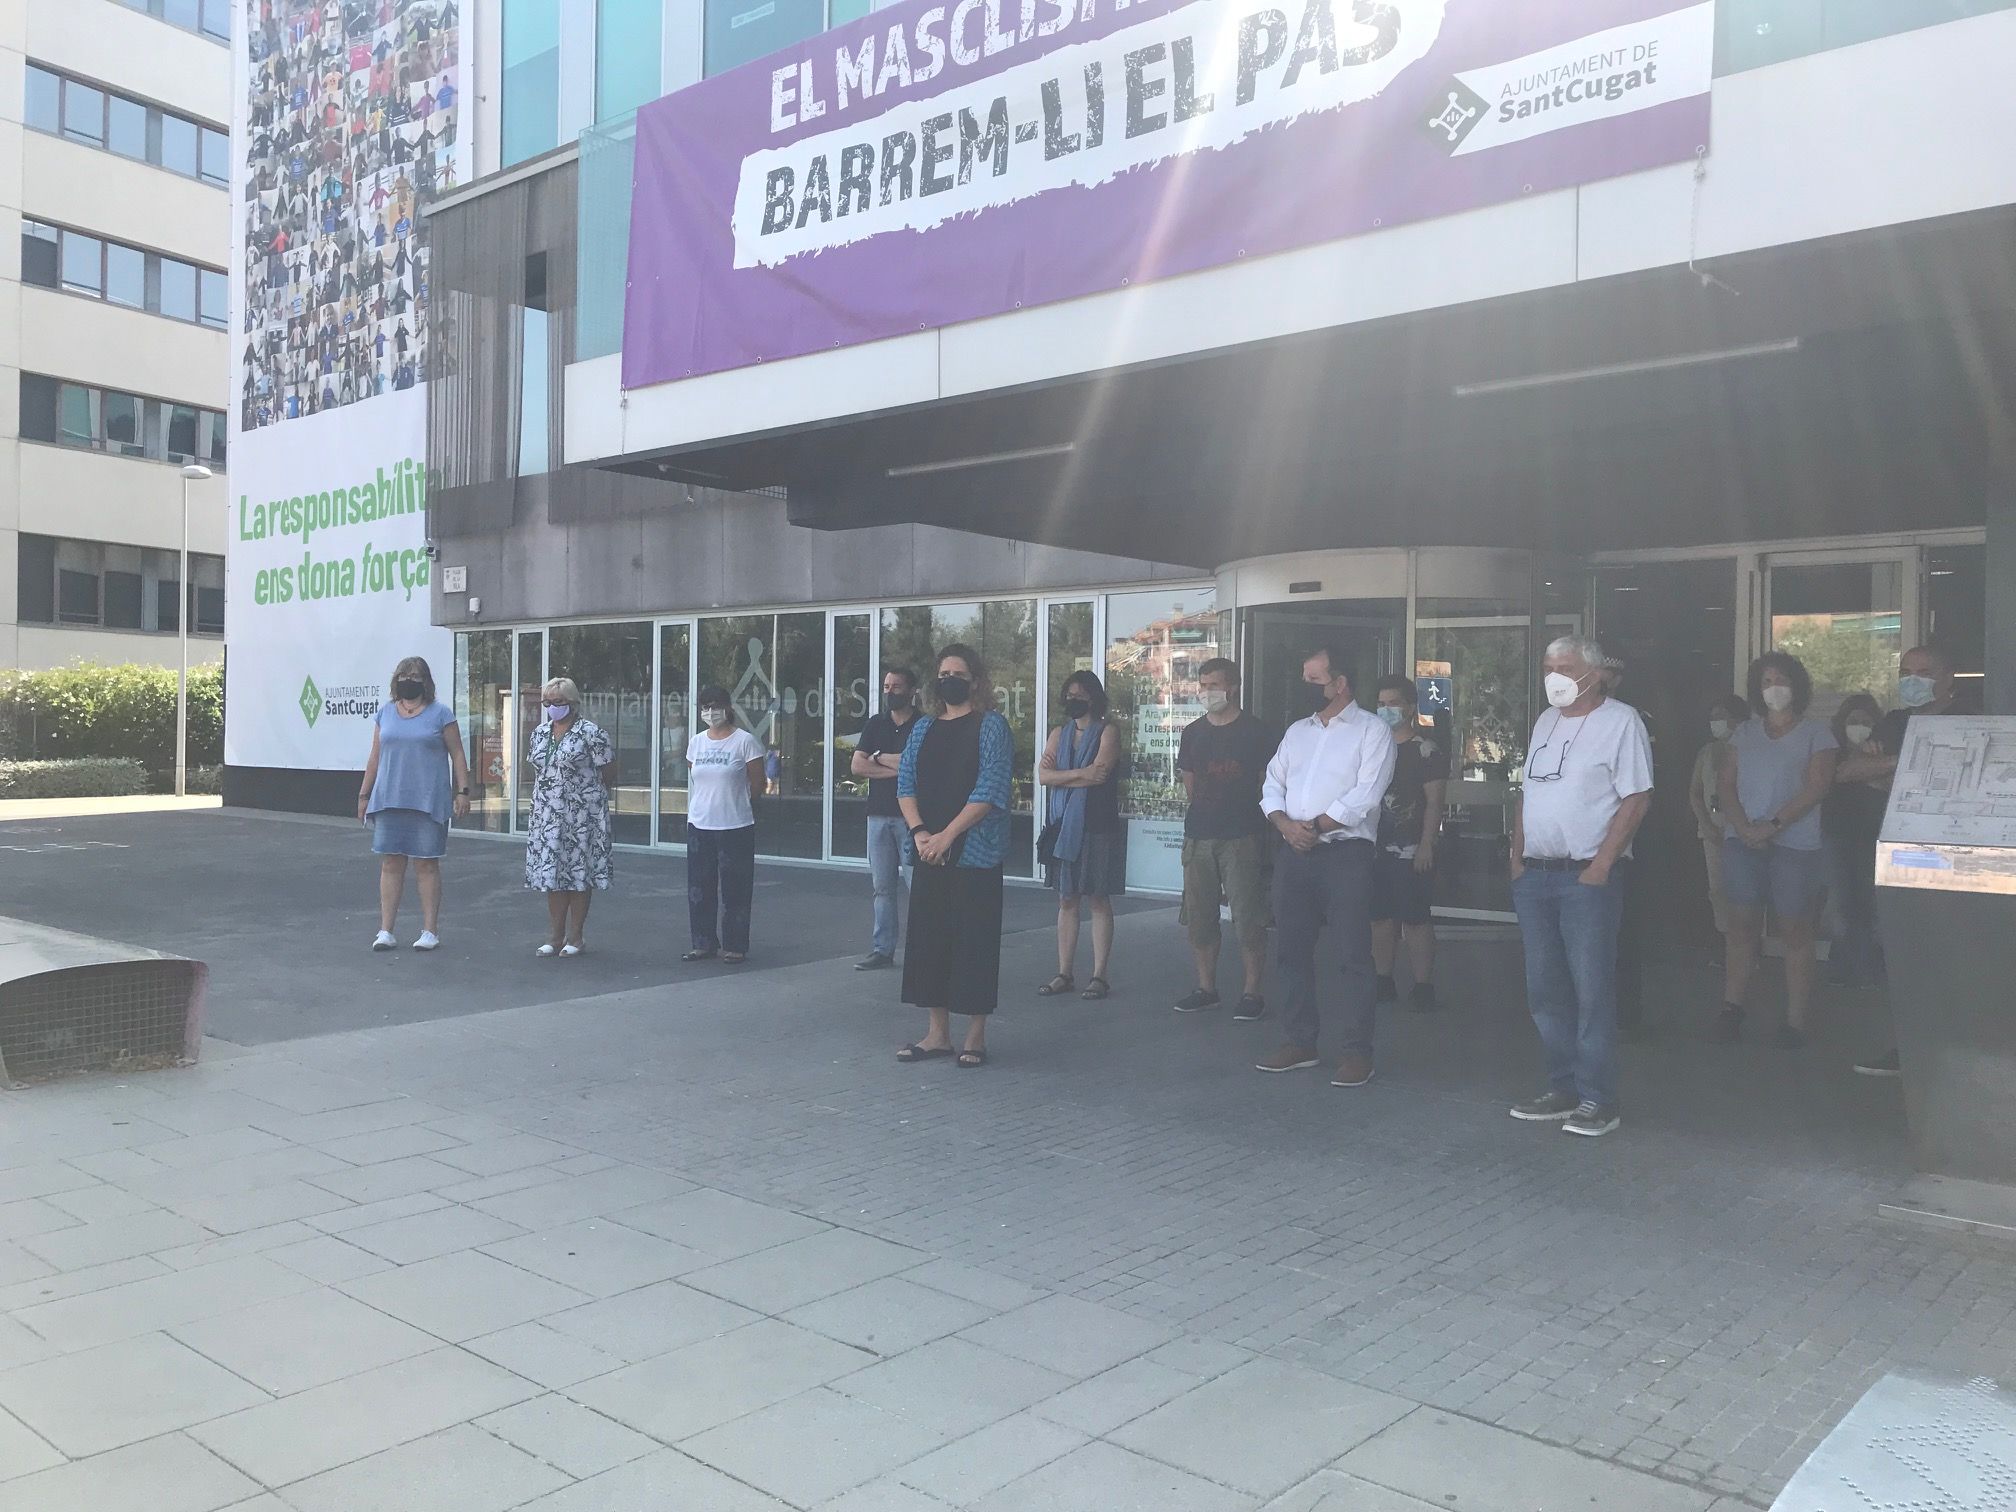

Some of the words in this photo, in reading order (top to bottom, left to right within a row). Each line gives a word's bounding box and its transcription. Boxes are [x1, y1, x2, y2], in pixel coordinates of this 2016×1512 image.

[770, 58, 827, 134] EL
[835, 0, 1153, 111] MASCLIS
[1497, 60, 1658, 124] SantCugat
[1500, 47, 1628, 99] AJUNTAMENT
[1632, 39, 1660, 63] DE
[760, 60, 1105, 237] BARREM-LI
[1123, 35, 1216, 140] EL
[1235, 0, 1402, 108] PAS
[240, 494, 266, 542] La
[254, 566, 294, 606] ens
[297, 551, 356, 602] dona
[361, 541, 432, 603] força
[325, 685, 370, 699] AJUNTAMENT
[371, 685, 381, 697] DE
[325, 698, 380, 719] SantCugat
[1144, 723, 1154, 734] La
[1150, 738, 1164, 748] ens
